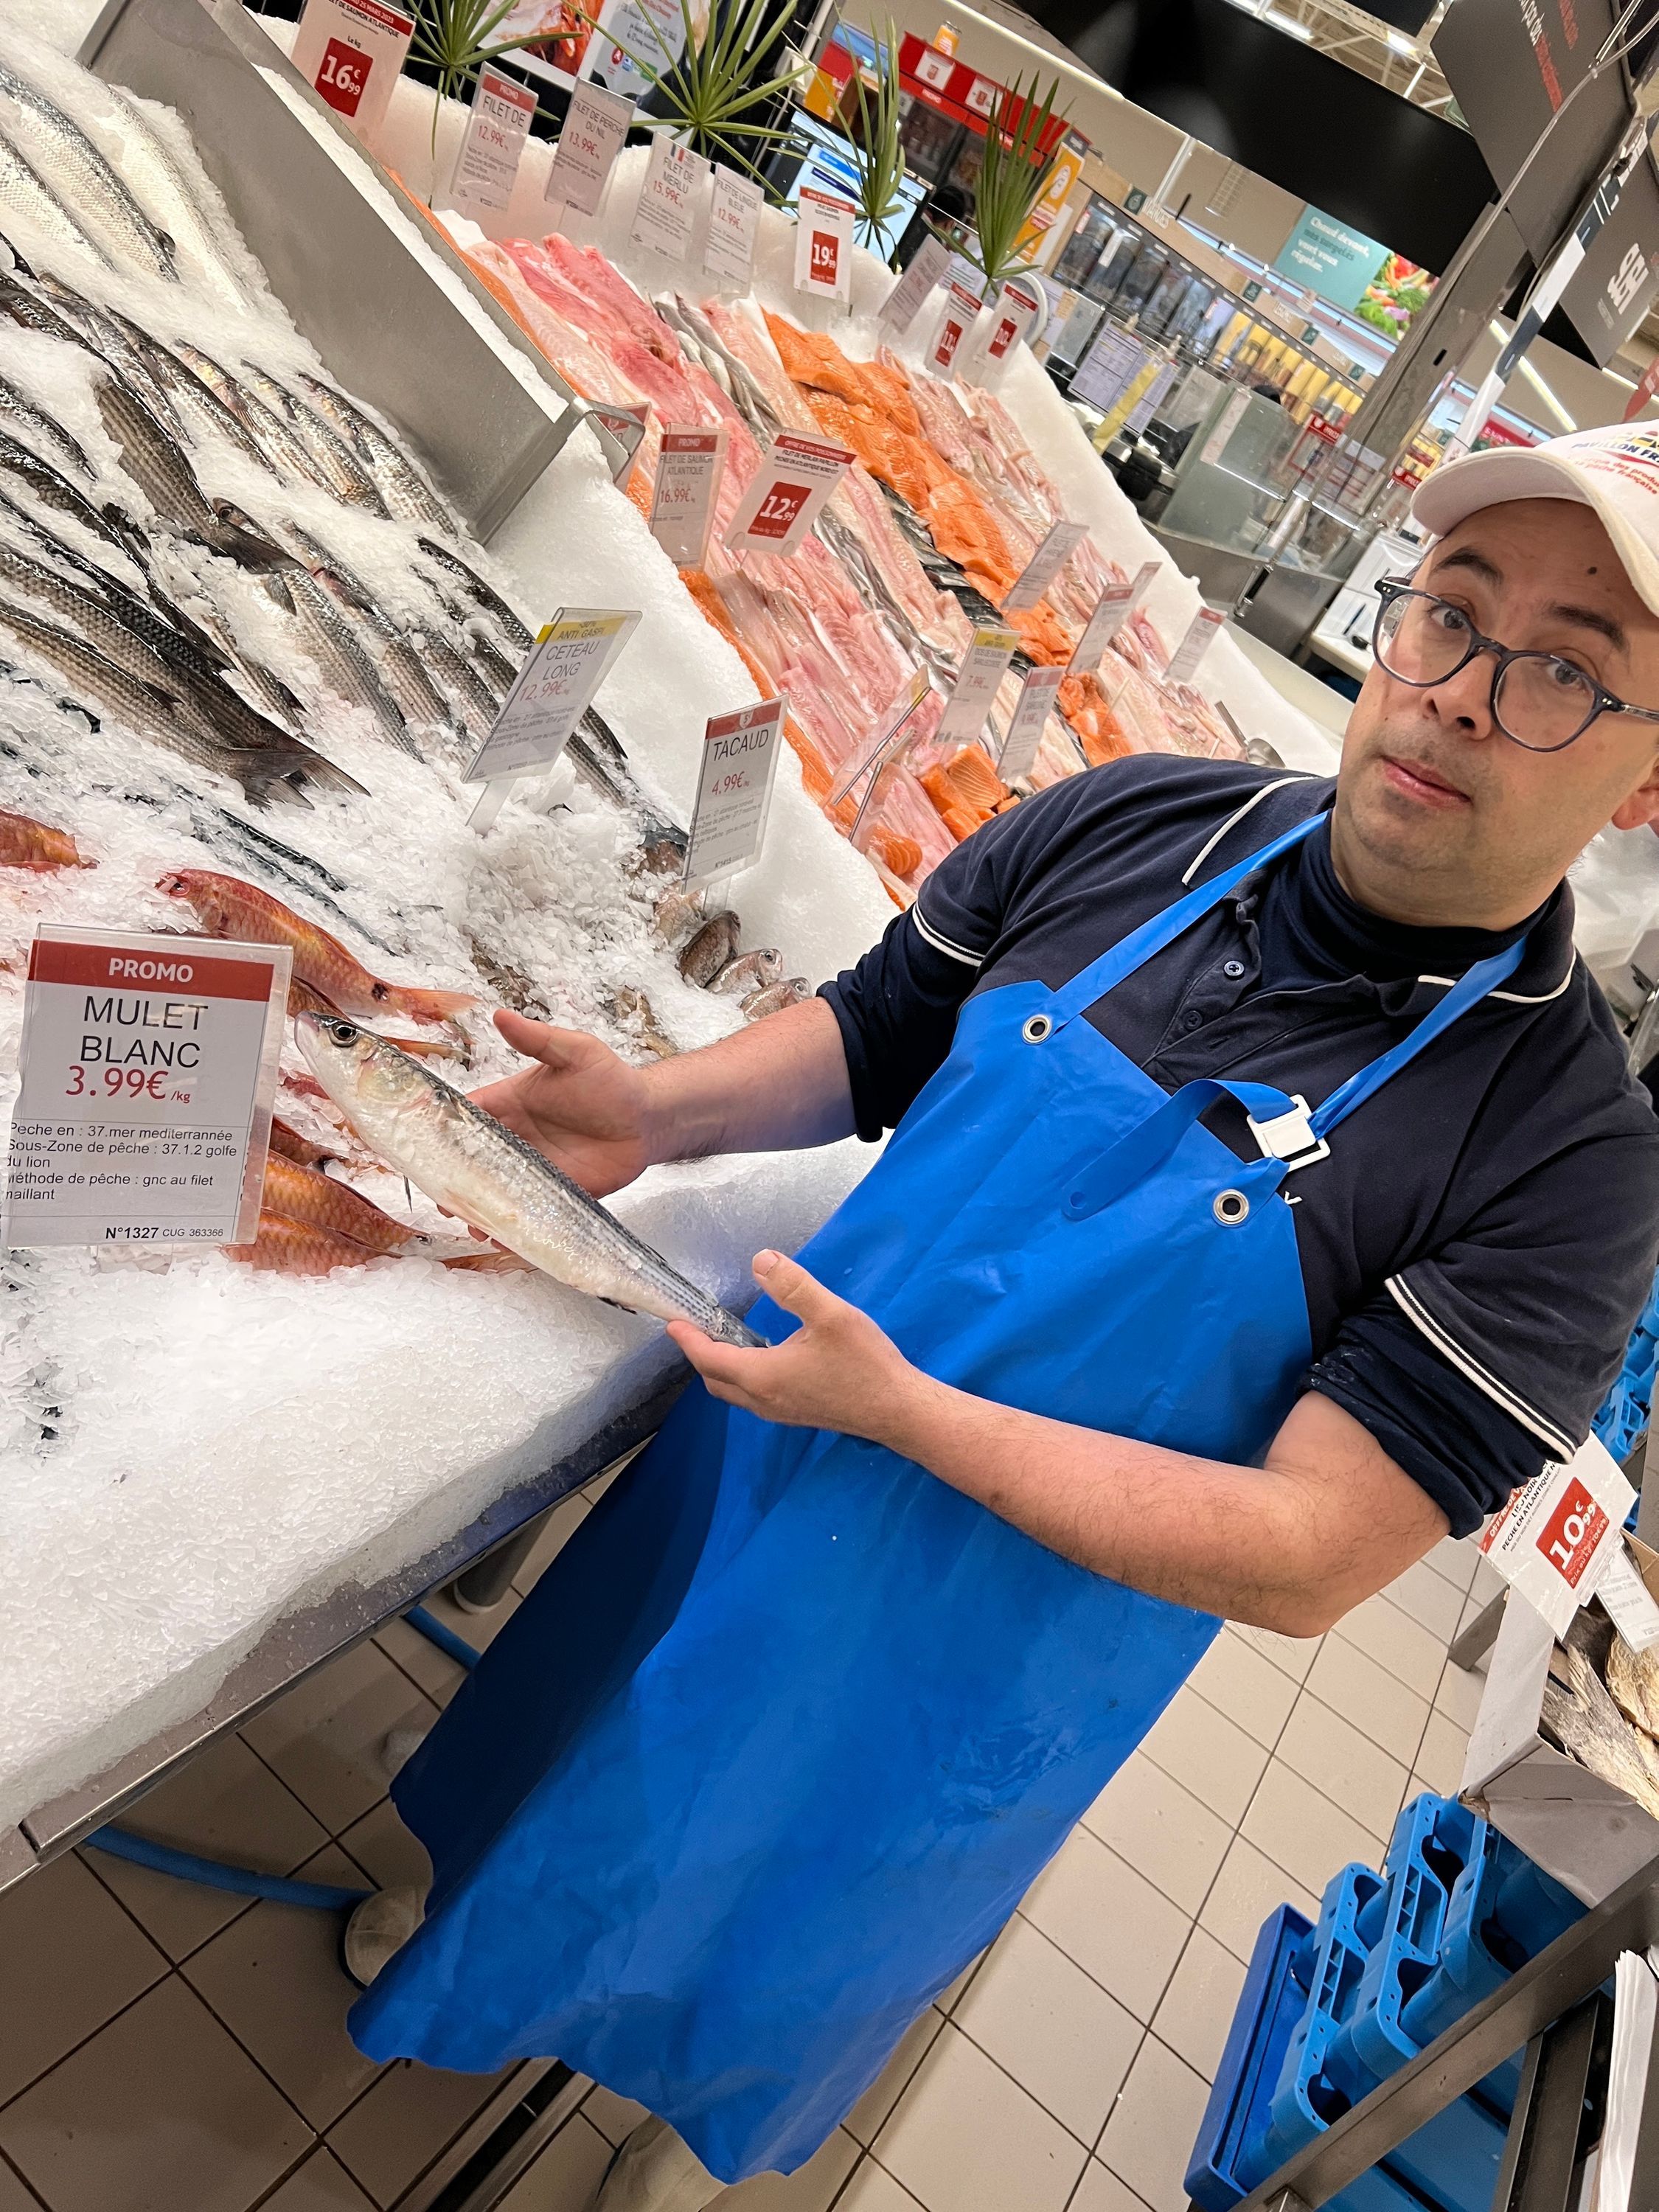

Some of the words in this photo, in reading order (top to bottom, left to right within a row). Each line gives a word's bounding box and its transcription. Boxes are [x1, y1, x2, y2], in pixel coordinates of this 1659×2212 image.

[346, 6, 369, 21] SAUMON
[369, 16, 400, 38] ATLANTIQUE
[483, 96, 511, 119] FILET
[510, 110, 526, 128] DE
[573, 100, 590, 116] FILET
[599, 116, 625, 136] PERCHE
[478, 125, 507, 147] 12.99€
[1571, 442, 1641, 453] PAVILLON
[667, 466, 704, 476] ATLANTIQUE
[1618, 469, 1658, 495] française
[660, 488, 692, 504] 16.99€
[557, 630, 580, 640] ANTI
[546, 640, 601, 661] CETEAU
[542, 661, 581, 681] LONG
[713, 728, 769, 762] TACAUD
[712, 771, 745, 796] 4.99€
[108, 957, 193, 983] PROMO
[83, 995, 209, 1030] MULET
[80, 1035, 201, 1068] BLANC
[66, 1065, 169, 1099] 3.99€
[170, 1091, 190, 1104] /kg
[57, 1127, 74, 1136] en
[139, 1129, 232, 1141] mediterrannée
[87, 1141, 104, 1153] de
[108, 1142, 150, 1155] pêche
[161, 1144, 202, 1155] 37.1.2
[206, 1145, 237, 1158] golfe
[27, 1155, 50, 1168] lion
[68, 1172, 85, 1183] de
[89, 1173, 131, 1187] pêche
[142, 1176, 167, 1188] gnc
[170, 1177, 187, 1185] au
[191, 1175, 213, 1186] filet
[105, 1227, 159, 1239] N°1327
[162, 1228, 185, 1237] CUG
[1502, 1526, 1518, 1551] PECHE
[1516, 1516, 1525, 1527] EN
[1523, 1469, 1552, 1517] ATLANTIQUE
